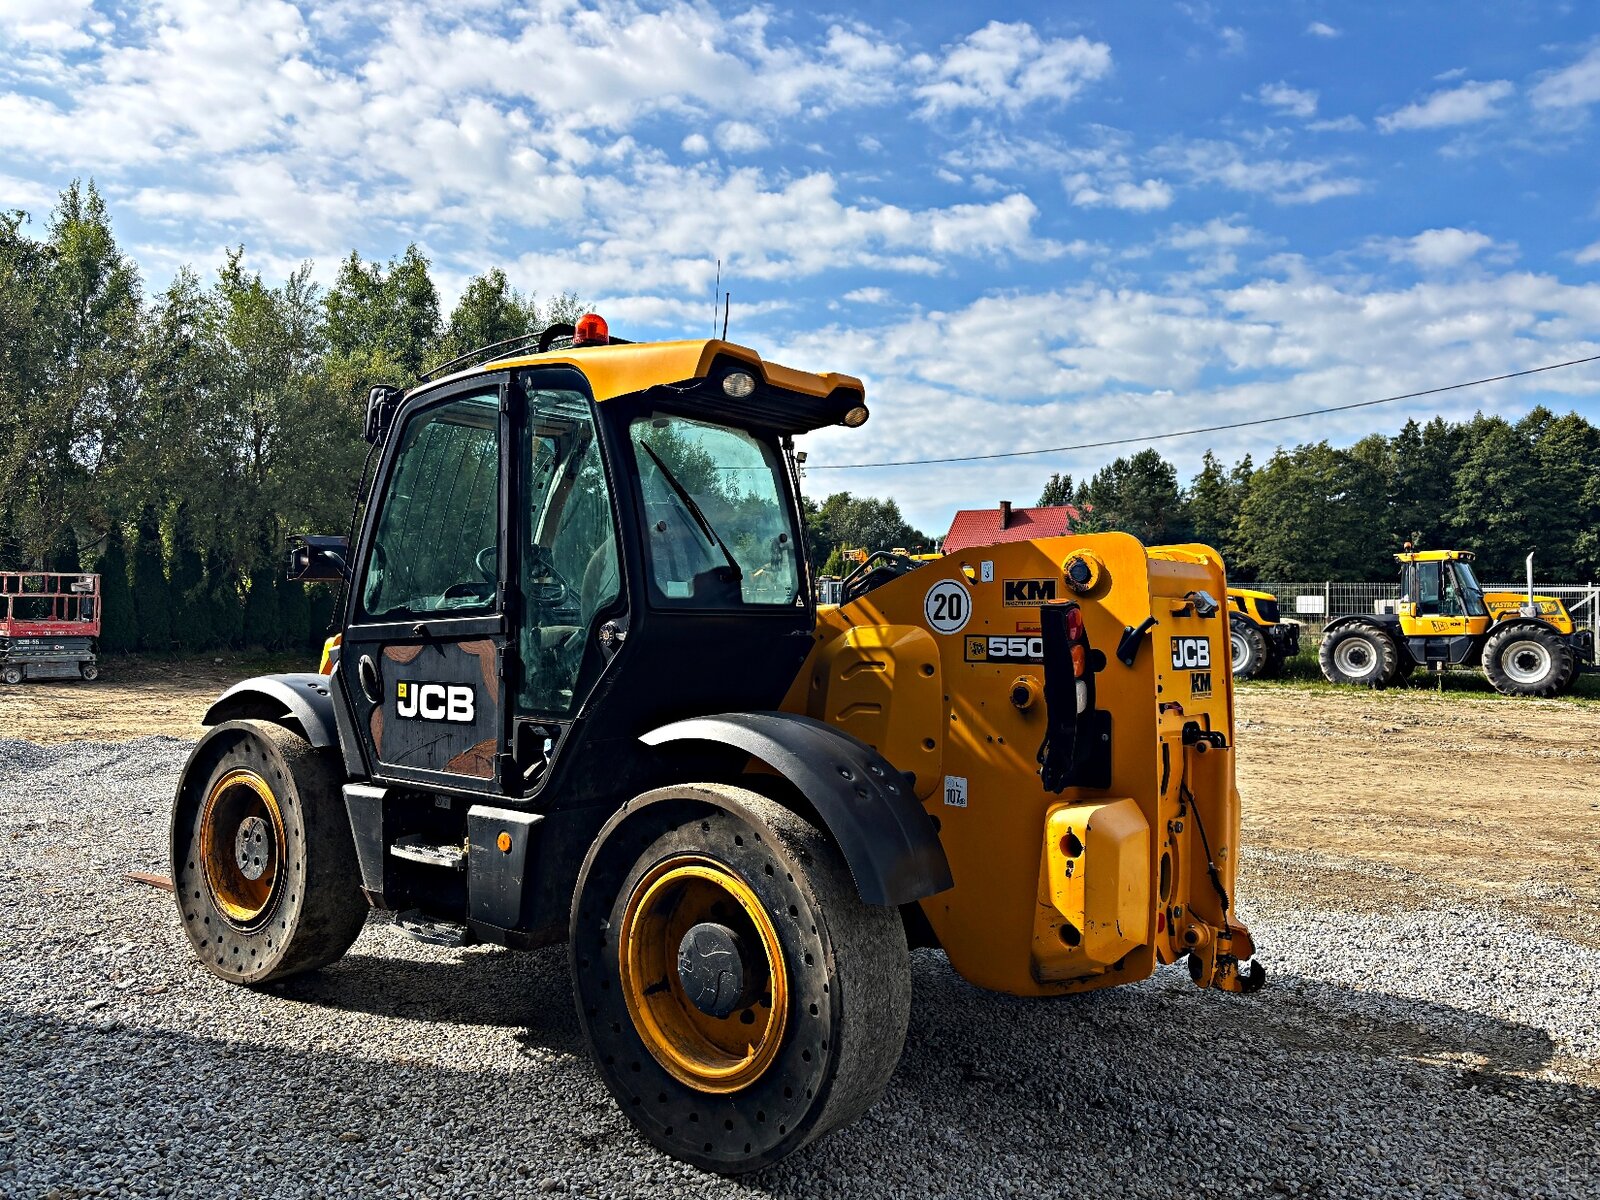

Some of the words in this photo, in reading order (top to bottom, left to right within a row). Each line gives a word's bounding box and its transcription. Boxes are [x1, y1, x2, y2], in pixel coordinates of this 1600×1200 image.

[1005, 580, 1056, 601] KM
[933, 593, 962, 621] 20
[1490, 601, 1521, 609] FASTRAC
[1172, 639, 1210, 668] JCB
[1191, 673, 1212, 693] KM
[397, 683, 474, 722] JCB
[946, 789, 961, 804] 107
